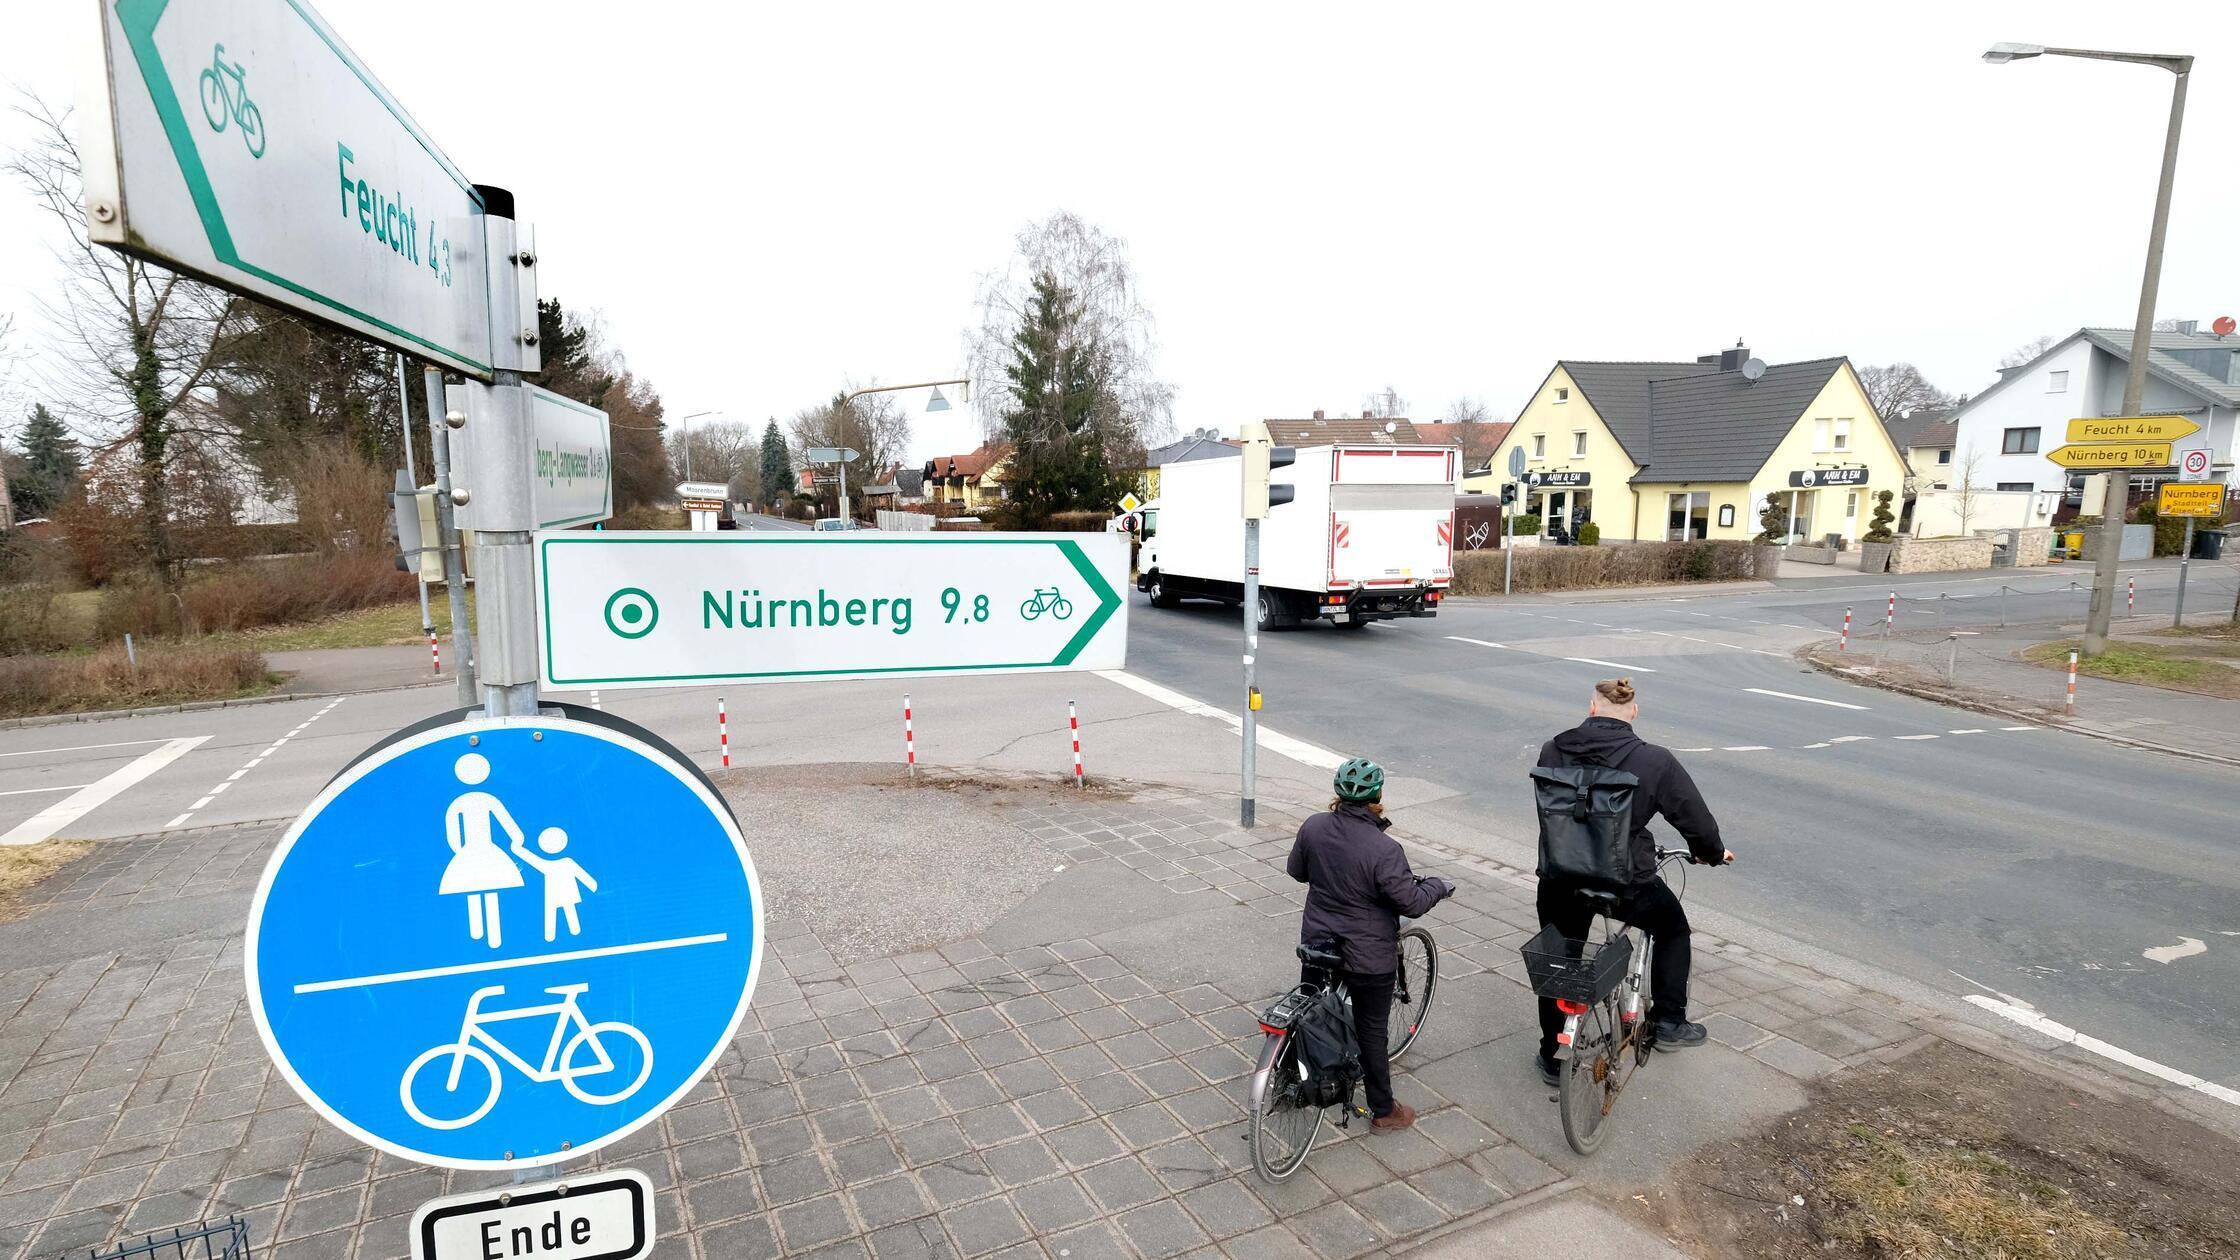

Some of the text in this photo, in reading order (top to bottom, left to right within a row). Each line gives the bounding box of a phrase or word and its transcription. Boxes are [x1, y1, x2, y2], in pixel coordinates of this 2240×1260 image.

[337, 141, 452, 287] Feucht 4,3
[2084, 424, 2162, 435] Feucht 4 km
[2067, 449, 2162, 462] Nürnberg 10 km
[2189, 457, 2203, 467] 30
[1563, 473, 1569, 482] &
[1570, 472, 1581, 481] EM
[1841, 470, 1848, 479] &
[1849, 470, 1860, 479] EM
[2165, 490, 2219, 500] Nürnberg
[703, 587, 989, 635] Nürnberg 9,8
[481, 1210, 591, 1260] Ende
